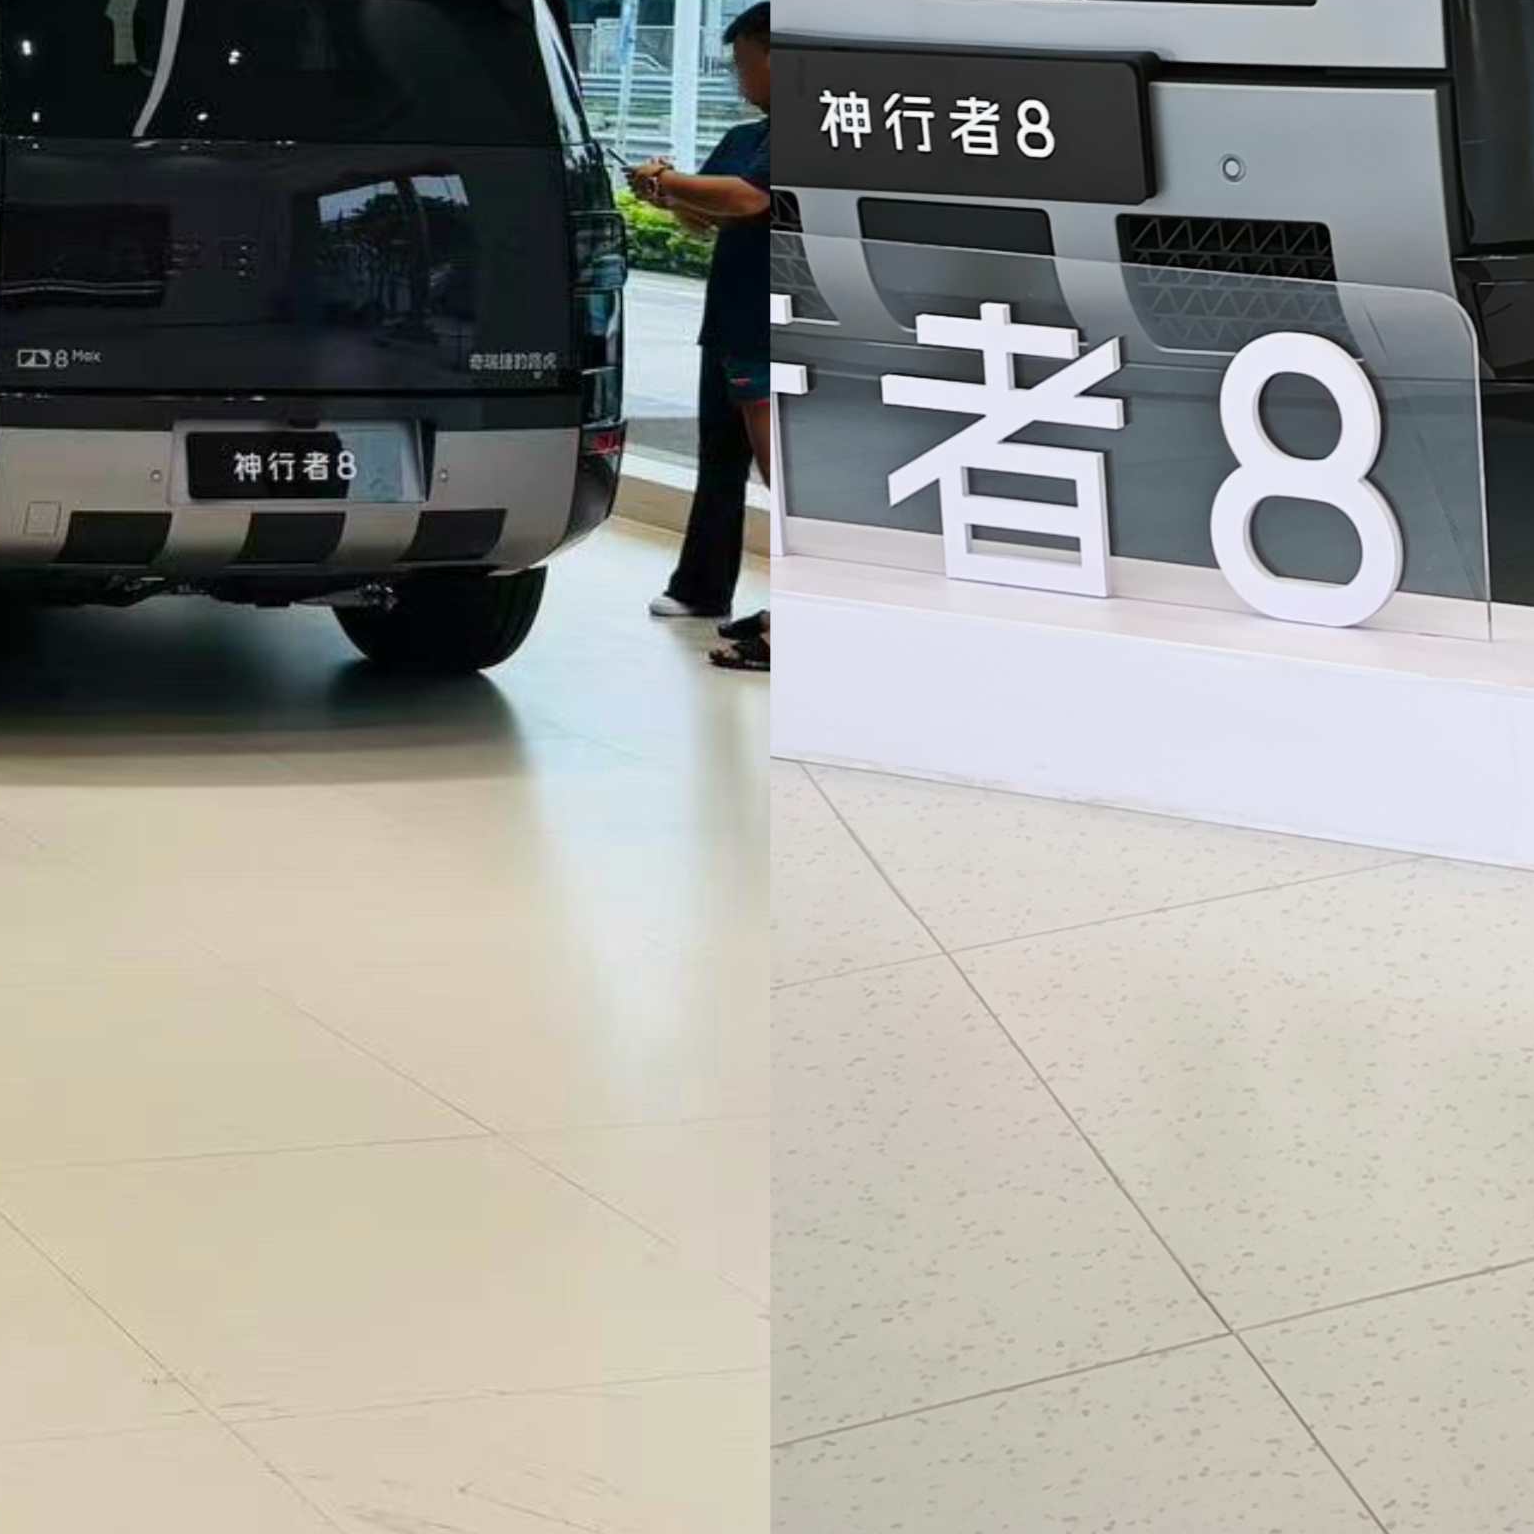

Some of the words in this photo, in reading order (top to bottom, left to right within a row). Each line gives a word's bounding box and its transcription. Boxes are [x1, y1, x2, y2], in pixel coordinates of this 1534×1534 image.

[819, 90, 1056, 158] 神行者8
[233, 450, 357, 482] 神行者8
